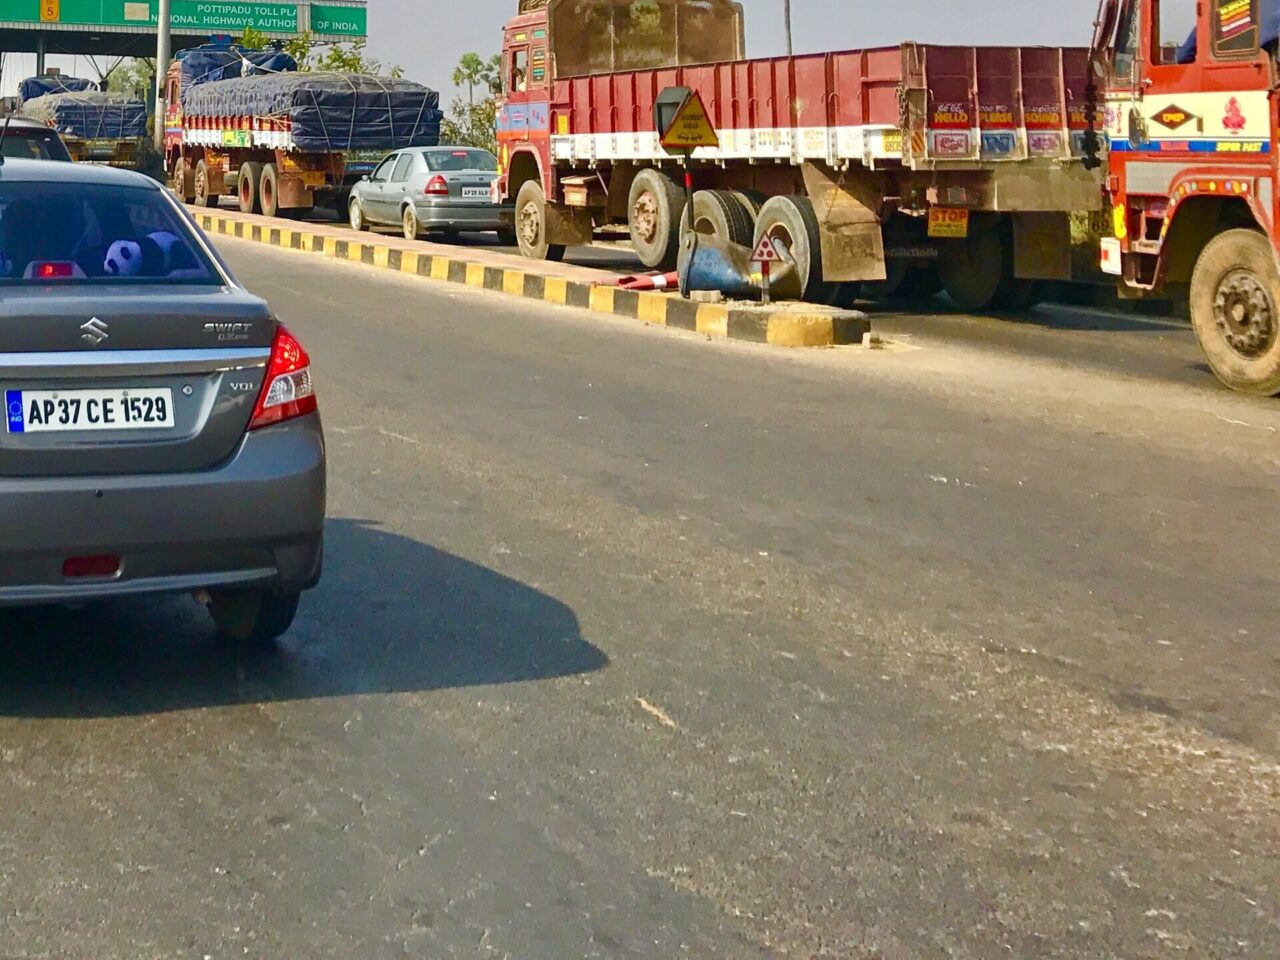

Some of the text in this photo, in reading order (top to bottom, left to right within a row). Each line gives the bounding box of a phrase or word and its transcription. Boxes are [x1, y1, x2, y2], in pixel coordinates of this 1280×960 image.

[46, 6, 55, 17] 5
[197, 4, 251, 16] POTTIPADU
[254, 7, 278, 16] TOLL
[151, 13, 358, 31] NIONAL HIGHWAYS AUTHOR OF INDIA
[934, 111, 1105, 124] HELLO PLEASE SOUND HON
[932, 209, 967, 222] STOP
[203, 323, 253, 333] SWIFT
[120, 396, 168, 423] 1529
